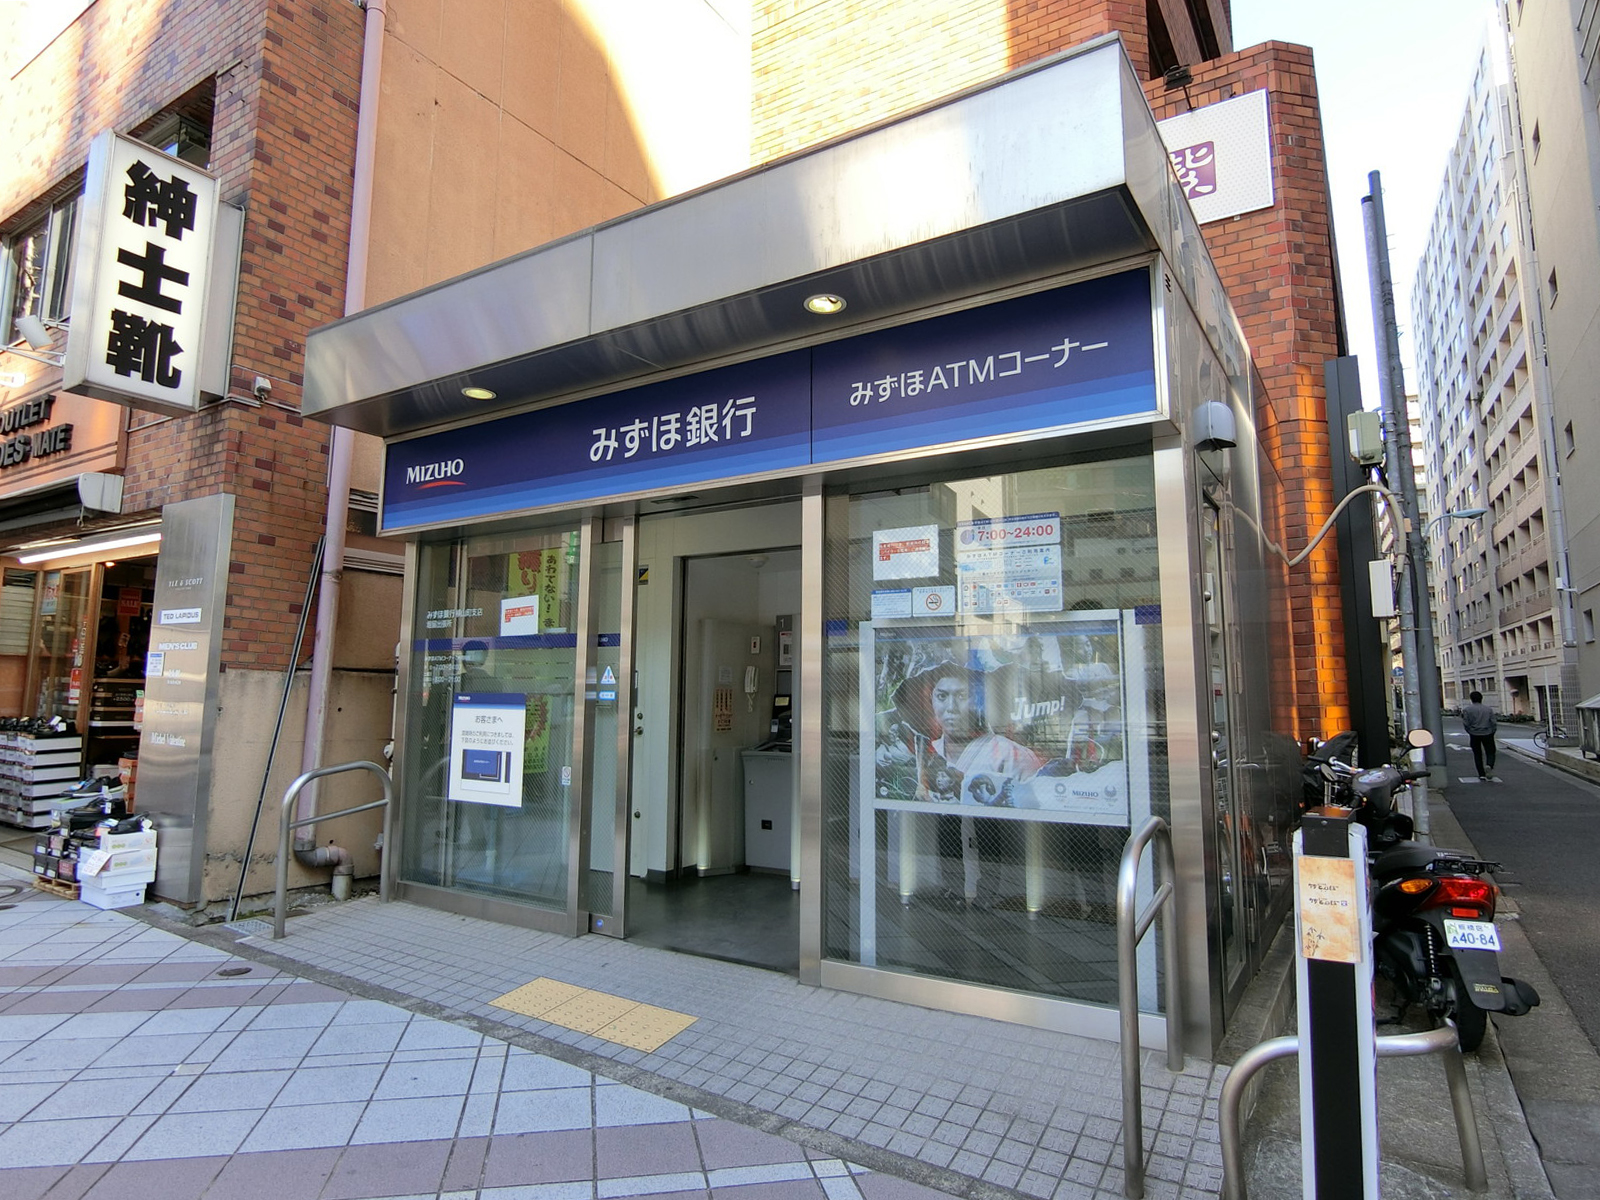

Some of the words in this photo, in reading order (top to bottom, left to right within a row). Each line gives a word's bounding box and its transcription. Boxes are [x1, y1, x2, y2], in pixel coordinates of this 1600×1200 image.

[105, 159, 198, 389] 紳士靴
[849, 337, 1109, 406] みずほATMコーナー
[589, 396, 757, 462] みずほ銀行
[405, 458, 464, 484] MIZUHO
[1010, 695, 1066, 721] Jump!
[1072, 790, 1099, 798] MIZUHO
